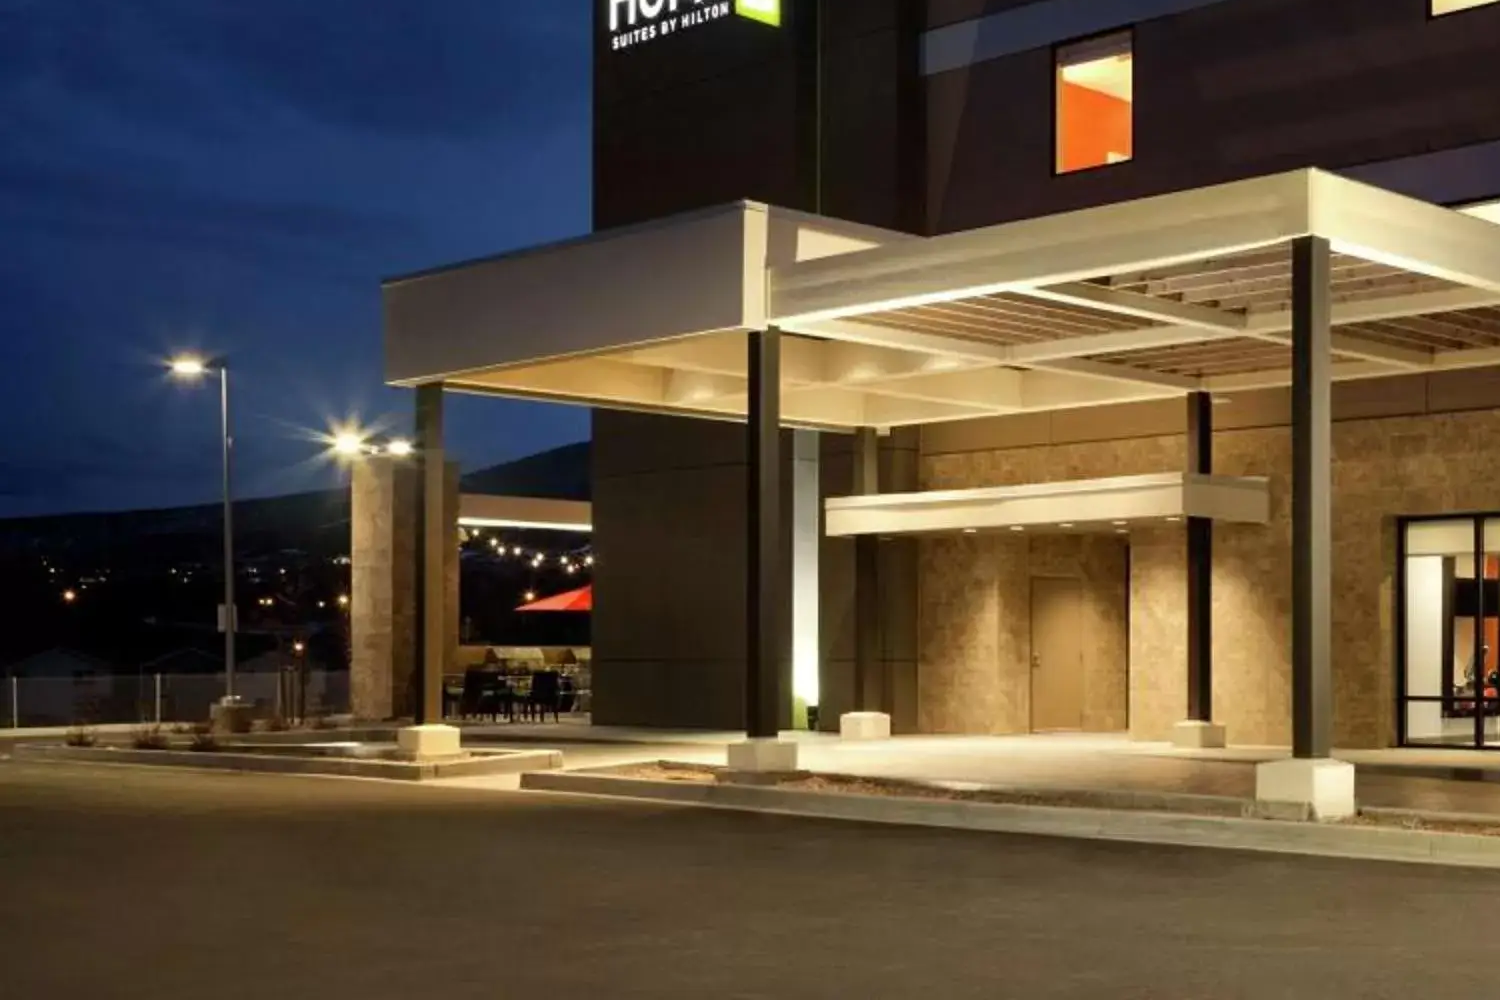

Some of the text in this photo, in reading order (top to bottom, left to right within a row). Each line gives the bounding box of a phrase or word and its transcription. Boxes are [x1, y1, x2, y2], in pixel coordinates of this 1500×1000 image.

[612, 2, 729, 50] SUITES BY HILTON
